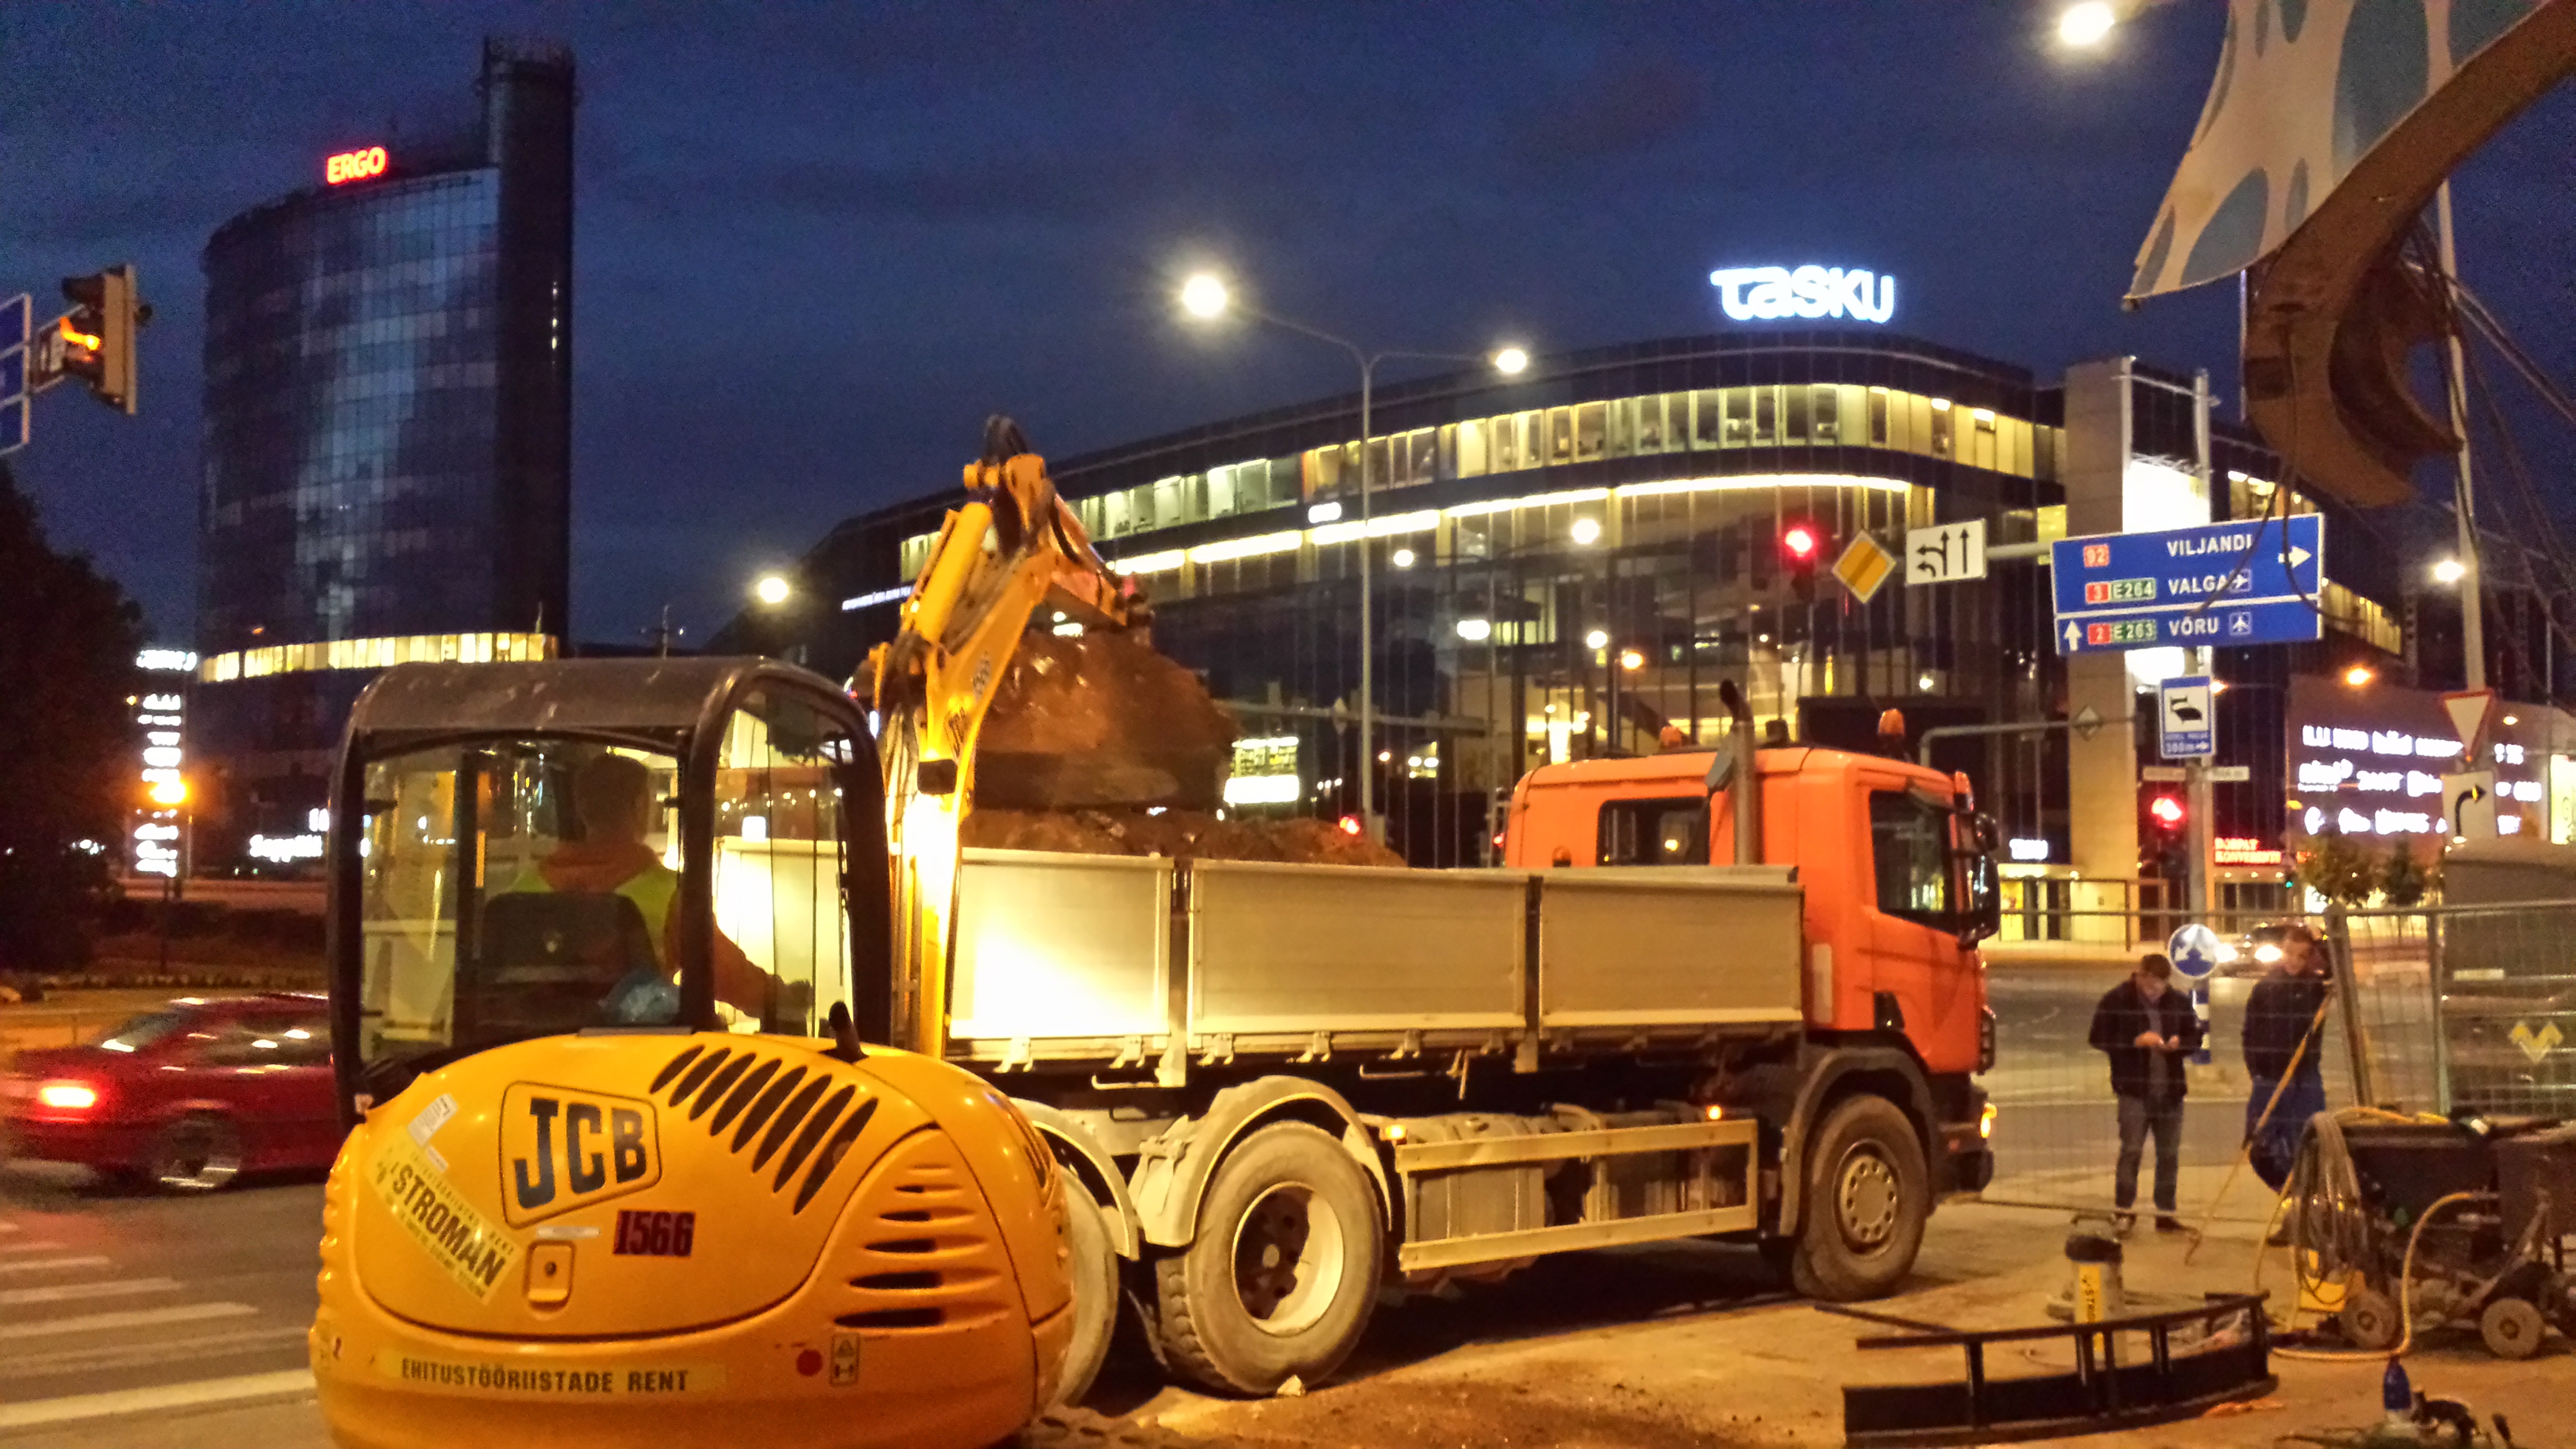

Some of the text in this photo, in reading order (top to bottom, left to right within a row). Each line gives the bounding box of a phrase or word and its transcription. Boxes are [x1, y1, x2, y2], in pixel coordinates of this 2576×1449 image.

[326, 146, 388, 184] ERGO
[2086, 534, 2252, 564] 92 VILJANDI
[2113, 580, 2152, 599] E264
[2168, 573, 2228, 596] VALGA
[2114, 622, 2154, 640] E263
[2169, 616, 2219, 637] VÕRU
[514, 1098, 646, 1209] JCB
[392, 1164, 506, 1287] STROMAN
[614, 1211, 695, 1256] 1566
[627, 1370, 688, 1393] RENT
